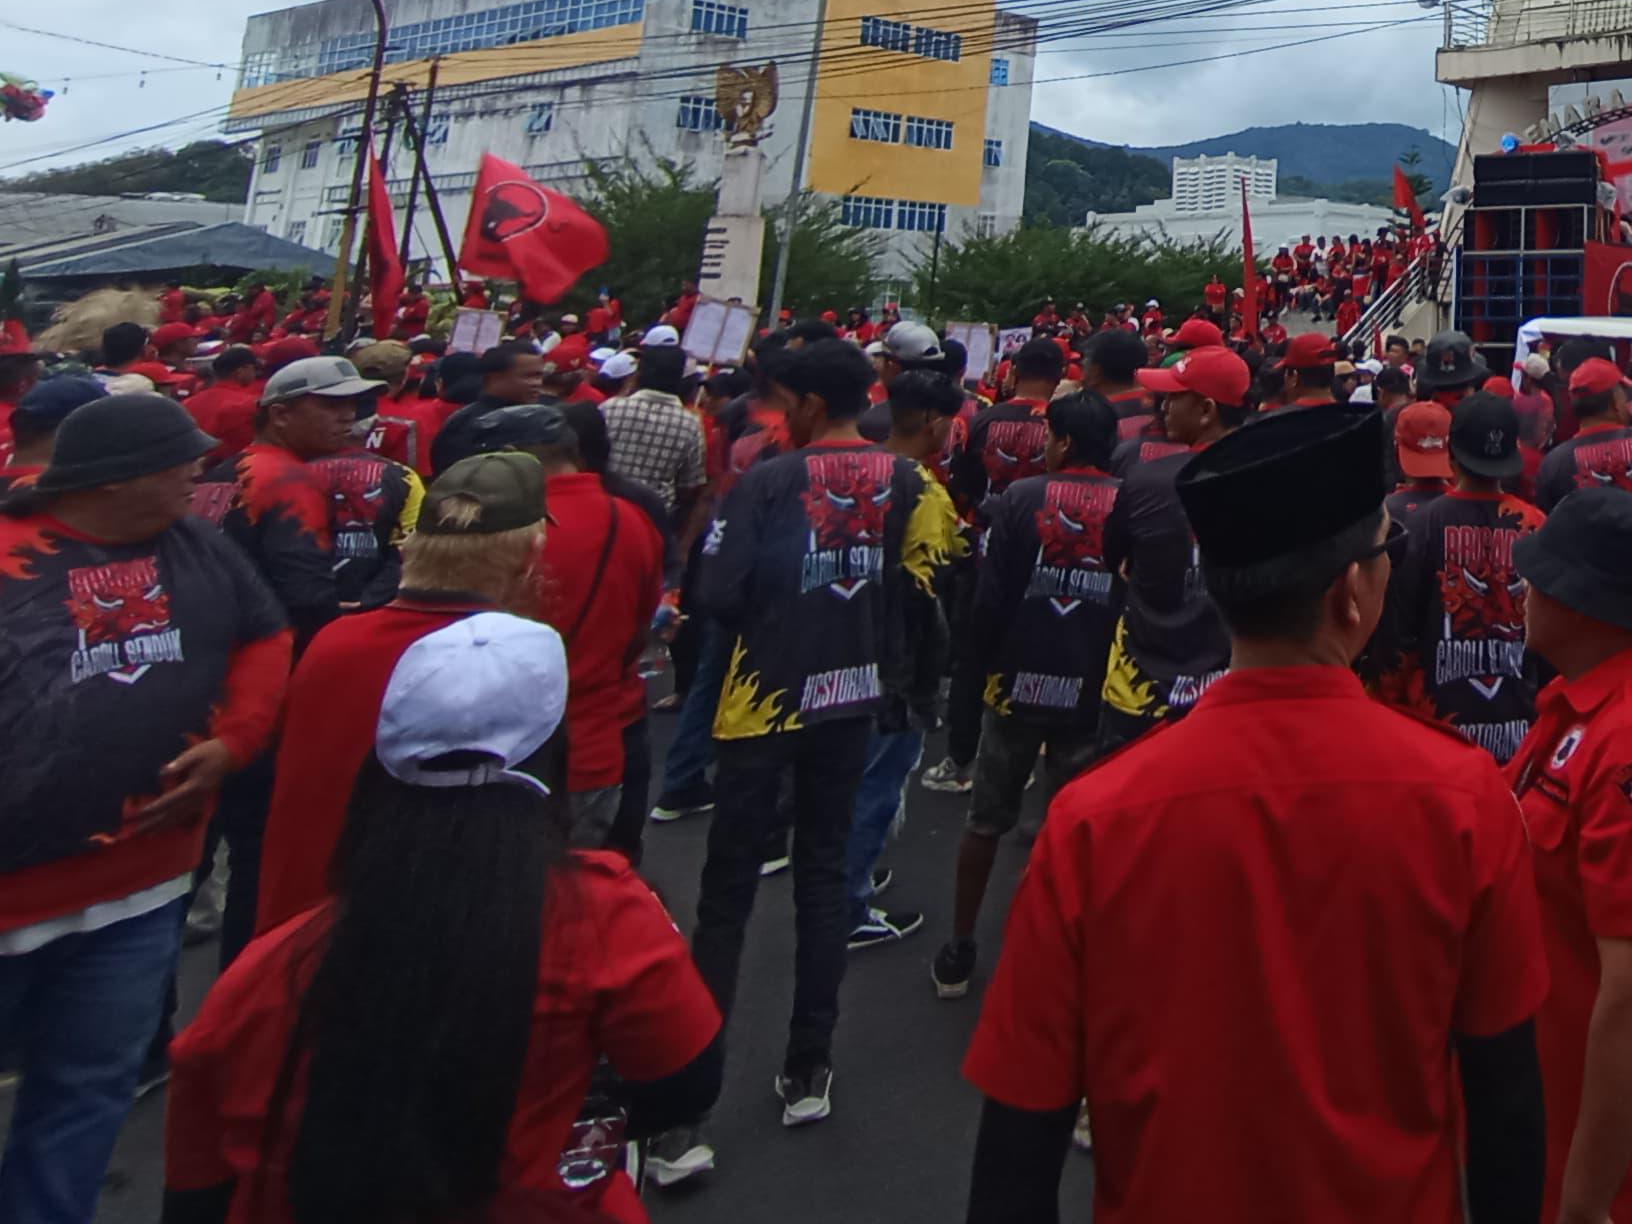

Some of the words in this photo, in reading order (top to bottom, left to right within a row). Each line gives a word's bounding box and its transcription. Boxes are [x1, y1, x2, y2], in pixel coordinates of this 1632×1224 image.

[801, 547, 844, 594] CAROLL
[71, 642, 124, 684] CAROLL
[124, 628, 185, 665] SENDUK
[1435, 639, 1486, 685] CAROLL
[801, 662, 881, 713] #CSTORAN
